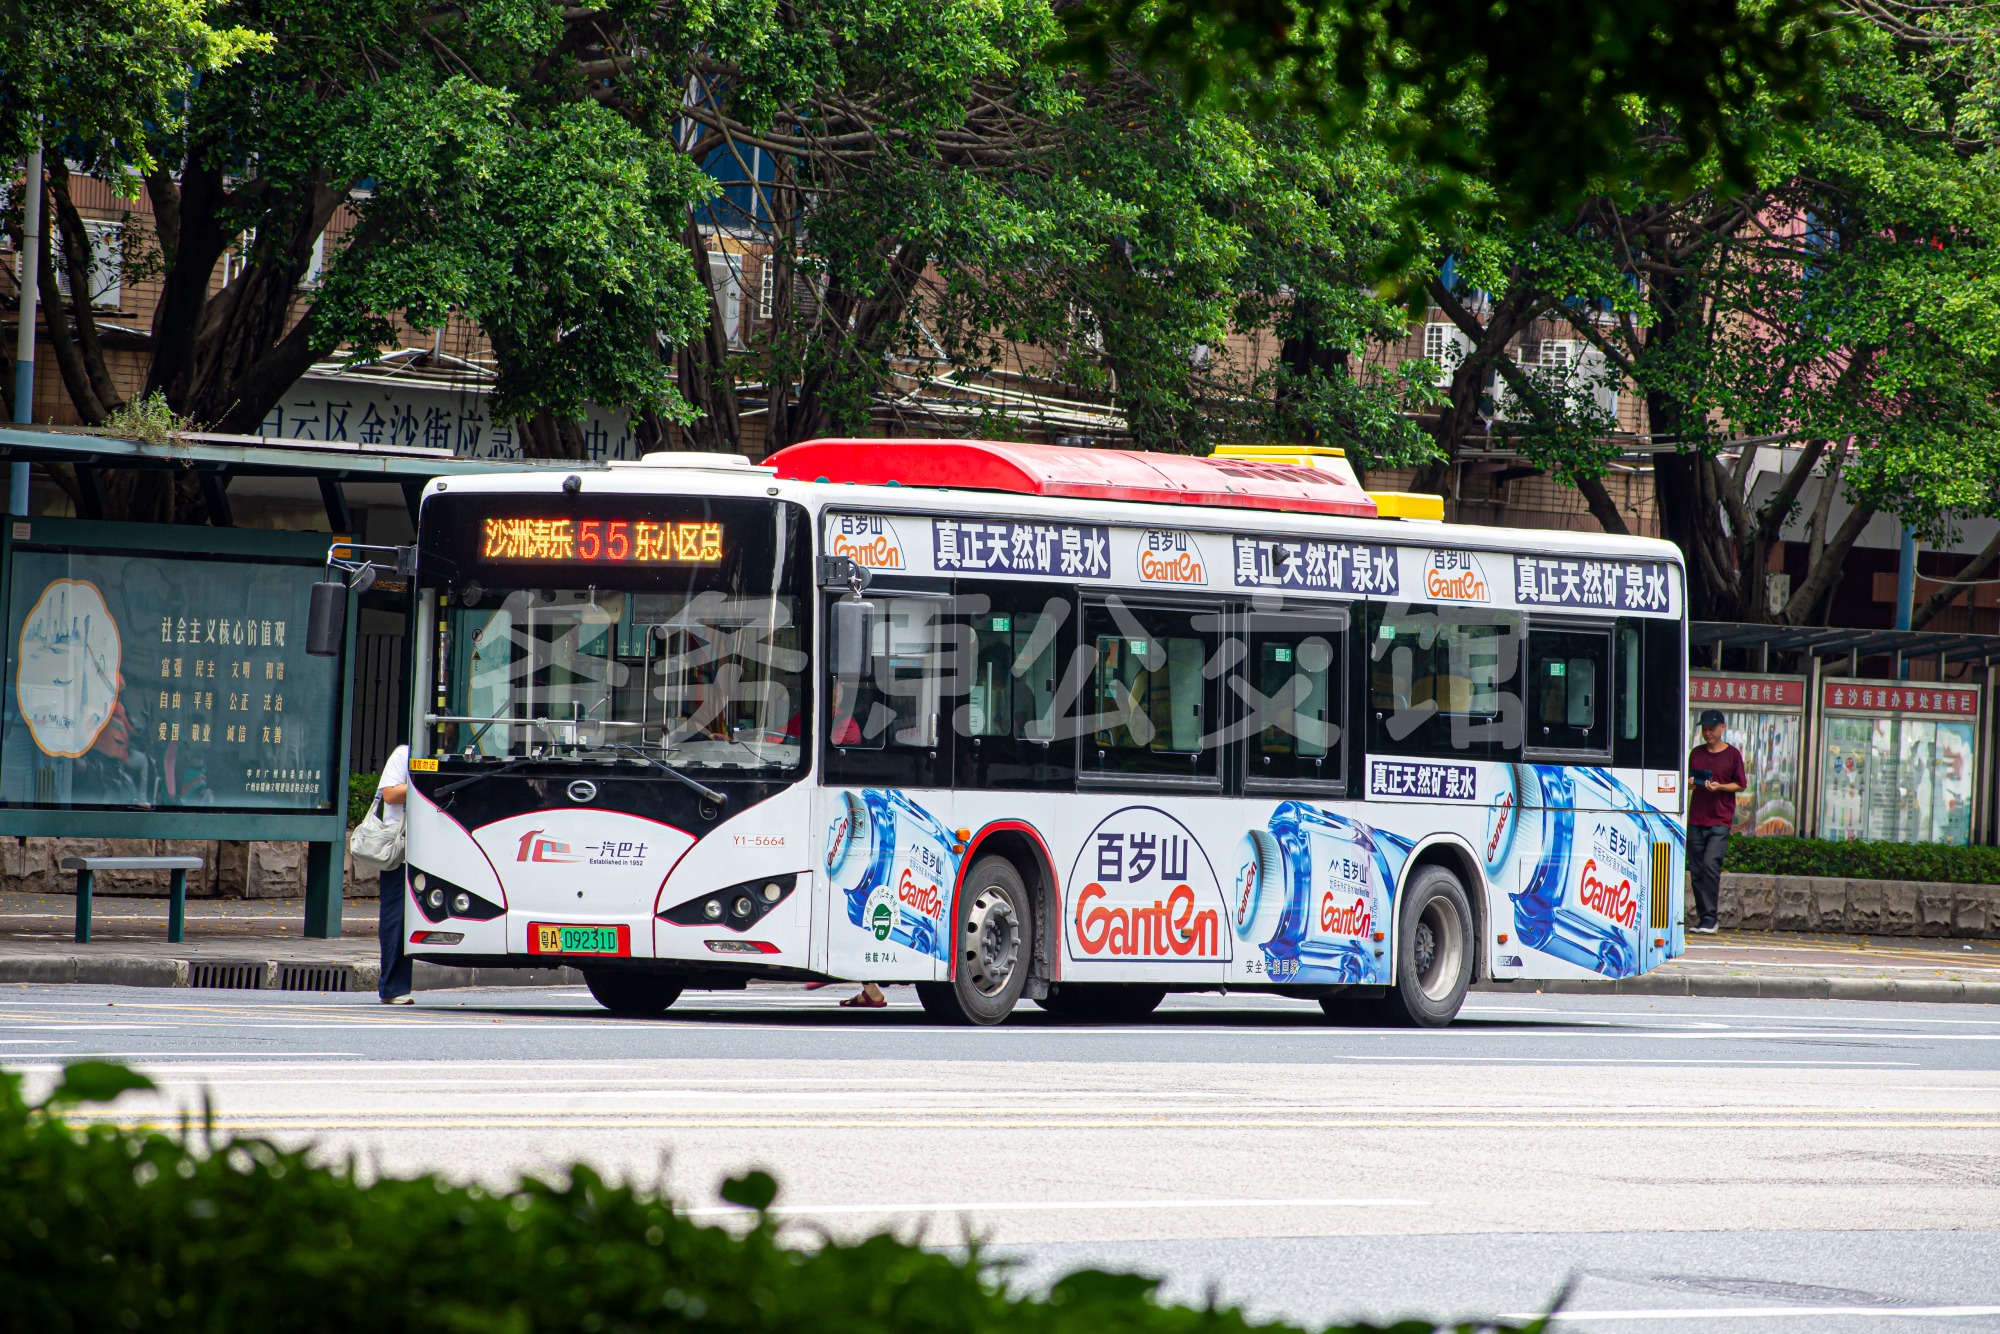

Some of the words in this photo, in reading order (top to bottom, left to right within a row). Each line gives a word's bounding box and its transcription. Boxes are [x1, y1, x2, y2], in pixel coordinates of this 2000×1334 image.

[841, 514, 883, 535] 百岁山
[579, 521, 629, 559] 55
[635, 522, 722, 560] 东小区总
[936, 519, 1108, 576] 真正天然矿泉水
[1147, 531, 1187, 551] 百岁山
[1141, 550, 1202, 583] Ganten
[1237, 537, 1397, 593] 真正天然矿泉水
[1434, 550, 1471, 570] 百岁山
[1428, 568, 1485, 600] Ganten
[1517, 556, 1667, 610] 真正天然矿泉水
[161, 617, 285, 646] 社会主义核心价值观
[161, 658, 182, 678] 富强
[195, 660, 215, 678] 民主
[231, 661, 251, 679] 文明
[265, 661, 284, 680] 和谐
[160, 691, 180, 709] 自由
[194, 692, 213, 710] 平等
[229, 692, 249, 711] 公正
[263, 694, 283, 712] 法治
[1833, 687, 1970, 711] 金沙街道办事处宣传栏
[158, 722, 180, 741] 爱国
[192, 724, 211, 741] 敬业
[226, 725, 246, 742] 诚信
[262, 726, 281, 743] 友善
[1373, 763, 1474, 798] 真正天然矿泉水
[585, 841, 649, 859] 一汽巴士
[734, 835, 785, 846] Y1-5664
[1610, 826, 1636, 866] 百岁山
[589, 858, 621, 866] Established
[1097, 832, 1188, 884] 百岁山
[1343, 858, 1367, 884] 百岁山
[1580, 858, 1637, 930] Ganten
[1076, 882, 1219, 957] Ganten
[1321, 891, 1371, 939] Ganten
[1245, 959, 1298, 975] 安全才能回家
